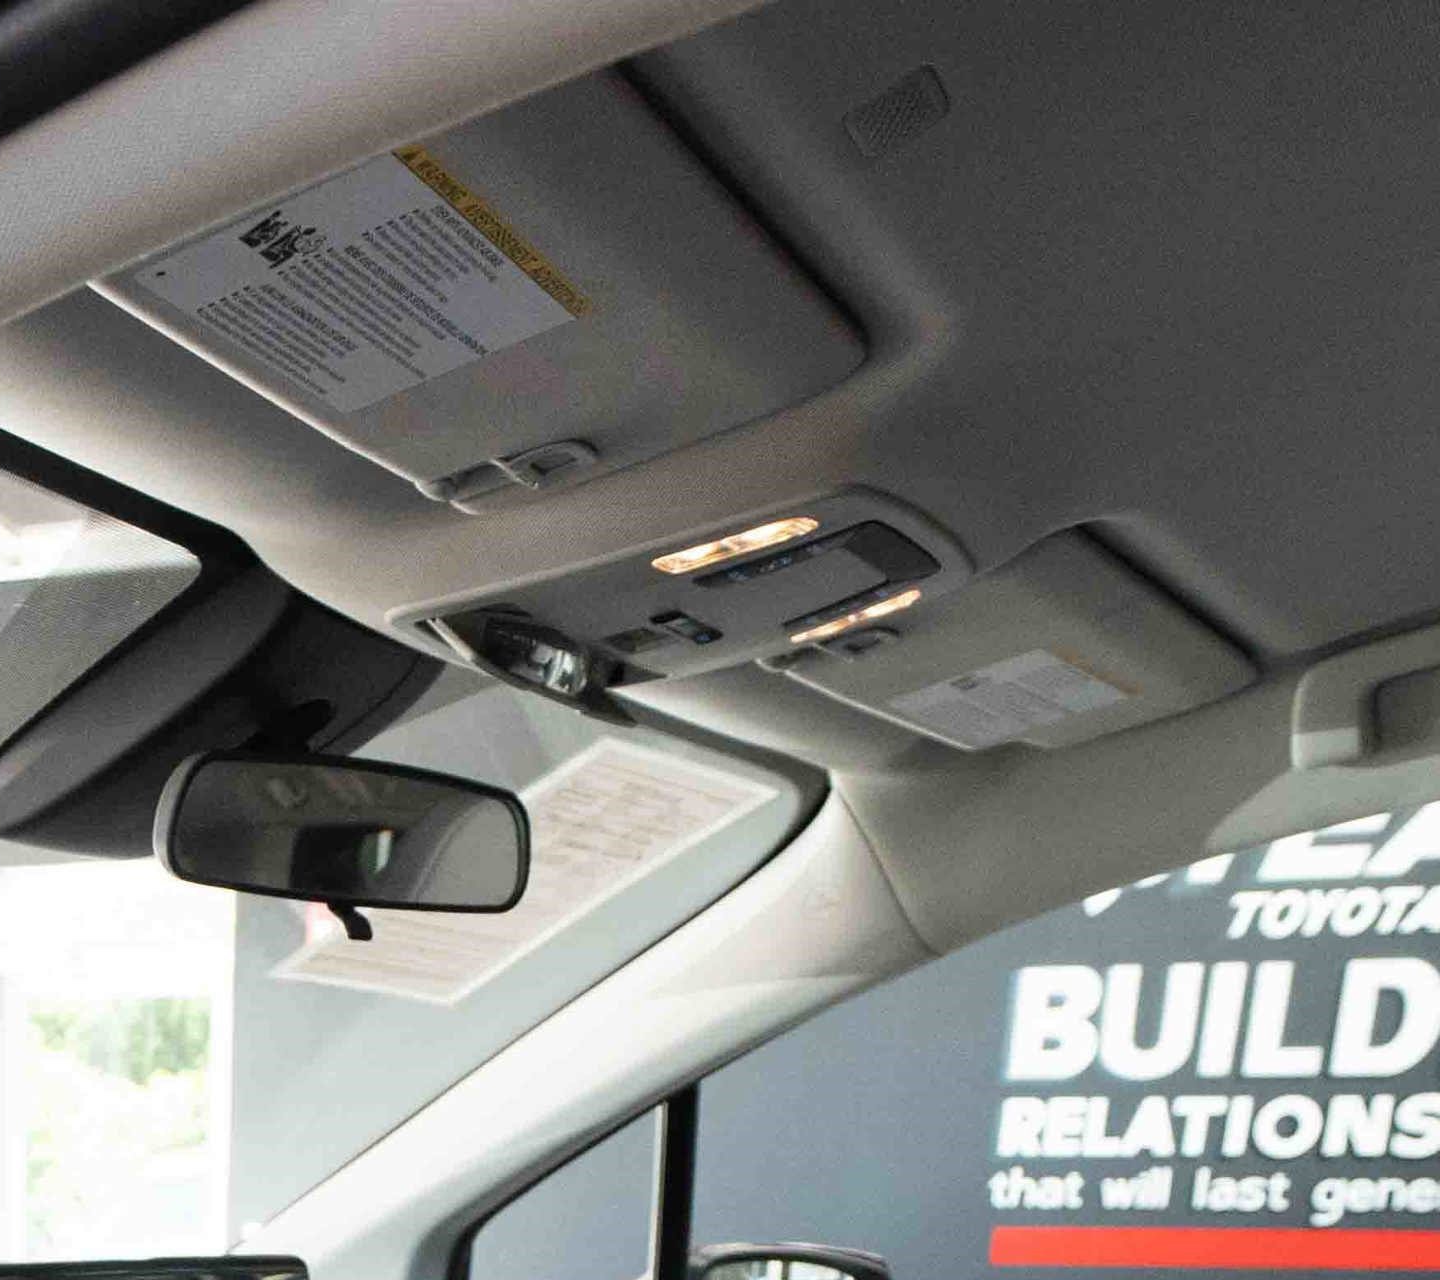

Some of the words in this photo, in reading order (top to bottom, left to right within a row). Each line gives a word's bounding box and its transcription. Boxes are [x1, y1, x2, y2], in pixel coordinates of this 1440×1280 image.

[988, 1167, 1085, 1210] that
[1101, 1167, 1174, 1210] will
[1193, 1169, 1291, 1211] last
